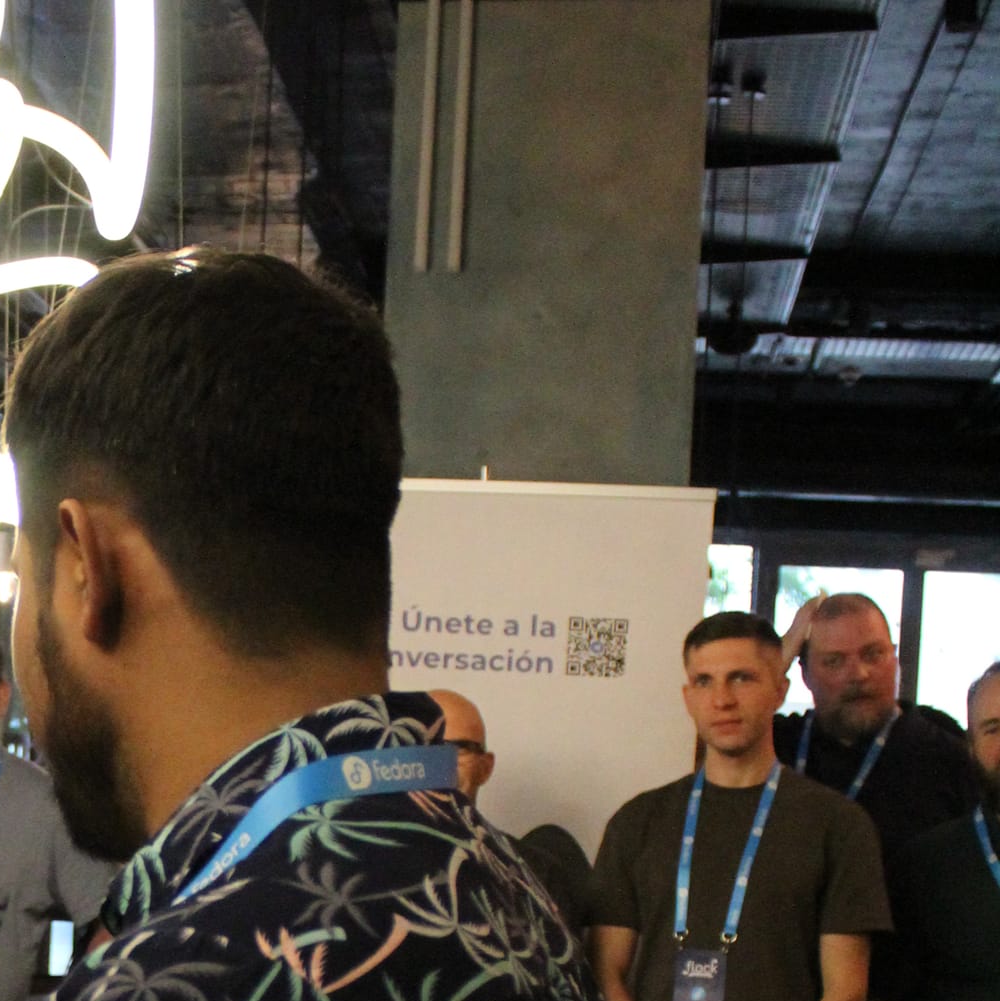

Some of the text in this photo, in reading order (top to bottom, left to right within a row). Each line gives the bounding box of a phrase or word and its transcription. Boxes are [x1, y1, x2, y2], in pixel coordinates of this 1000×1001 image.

[402, 604, 556, 638] Únete a la
[386, 648, 554, 674] nversación
[373, 761, 426, 782] fedora
